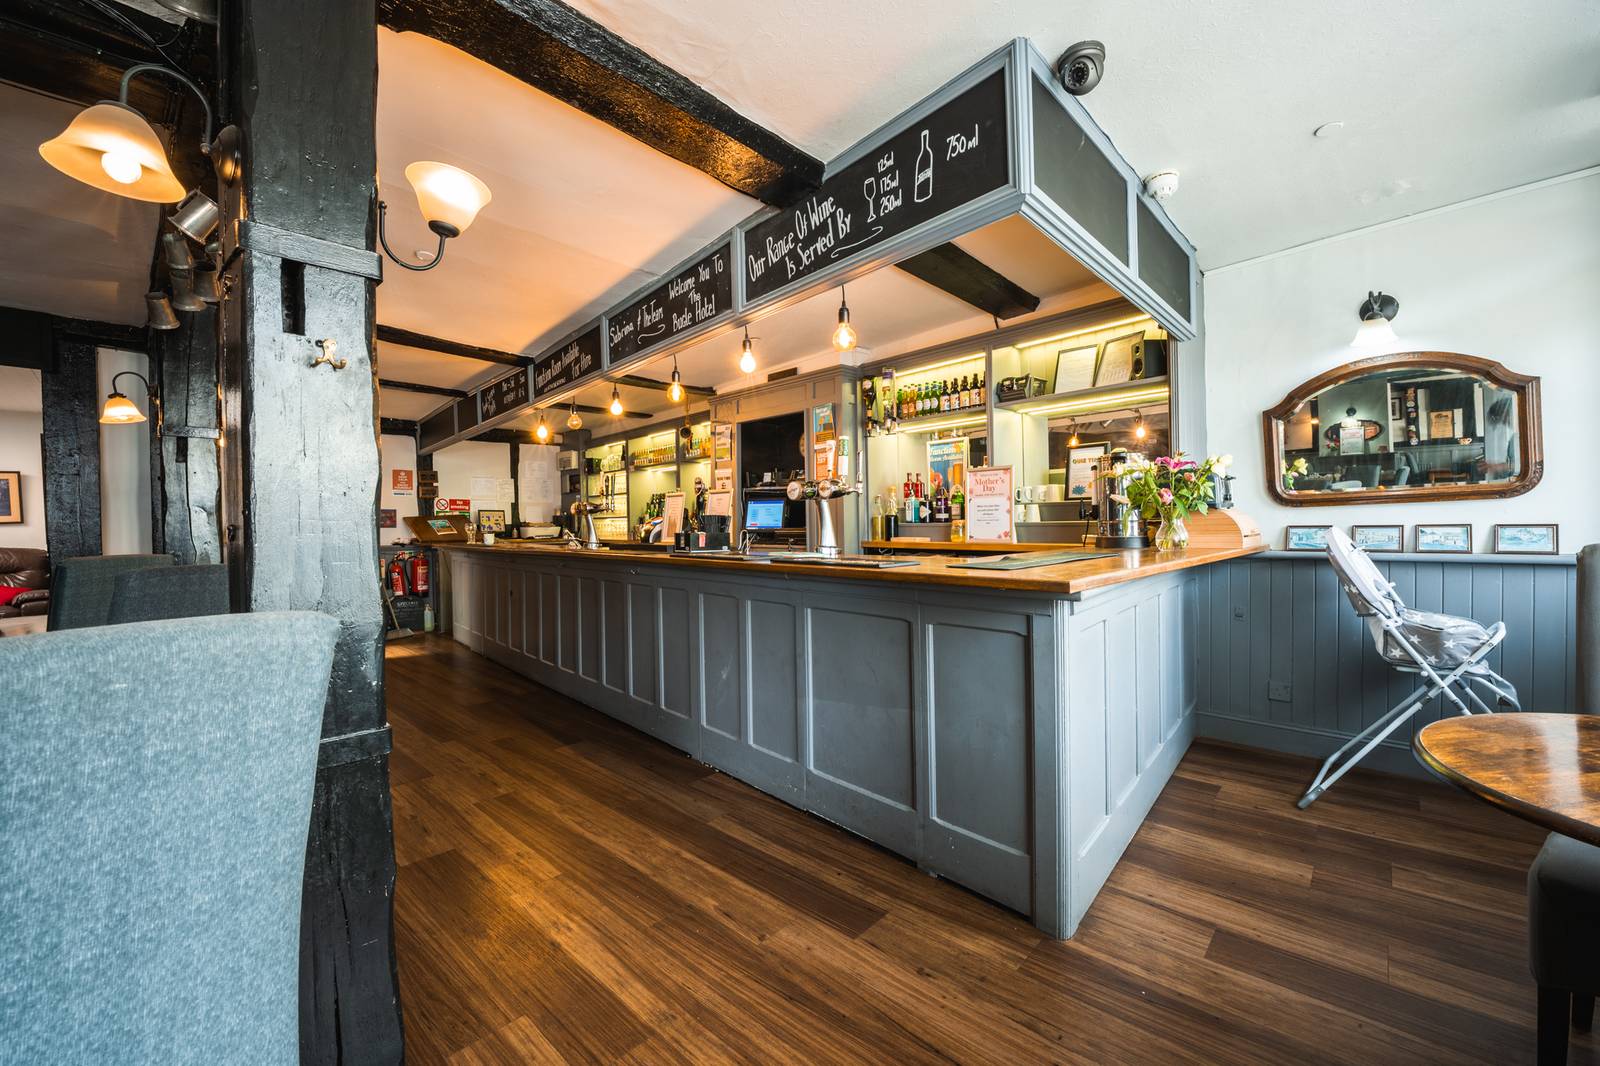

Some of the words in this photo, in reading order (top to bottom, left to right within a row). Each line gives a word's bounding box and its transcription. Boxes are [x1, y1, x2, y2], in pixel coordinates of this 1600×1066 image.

[877, 151, 894, 174] 125ml
[880, 169, 899, 195] 175ml
[880, 189, 902, 217] 250ml
[748, 254, 766, 282] Our
[766, 231, 795, 268] Range
[795, 209, 808, 240] Of
[806, 196, 836, 230] Wine
[785, 255, 796, 280] Is
[797, 217, 834, 271] Served
[836, 207, 851, 240] By
[668, 275, 695, 301] Welcome
[698, 263, 710, 283] You
[712, 253, 724, 275] To
[687, 288, 701, 305] The
[695, 293, 716, 323] Hotel
[609, 320, 634, 347] Sabrina
[975, 477, 1005, 487] Mother's
[982, 484, 996, 493] Day
